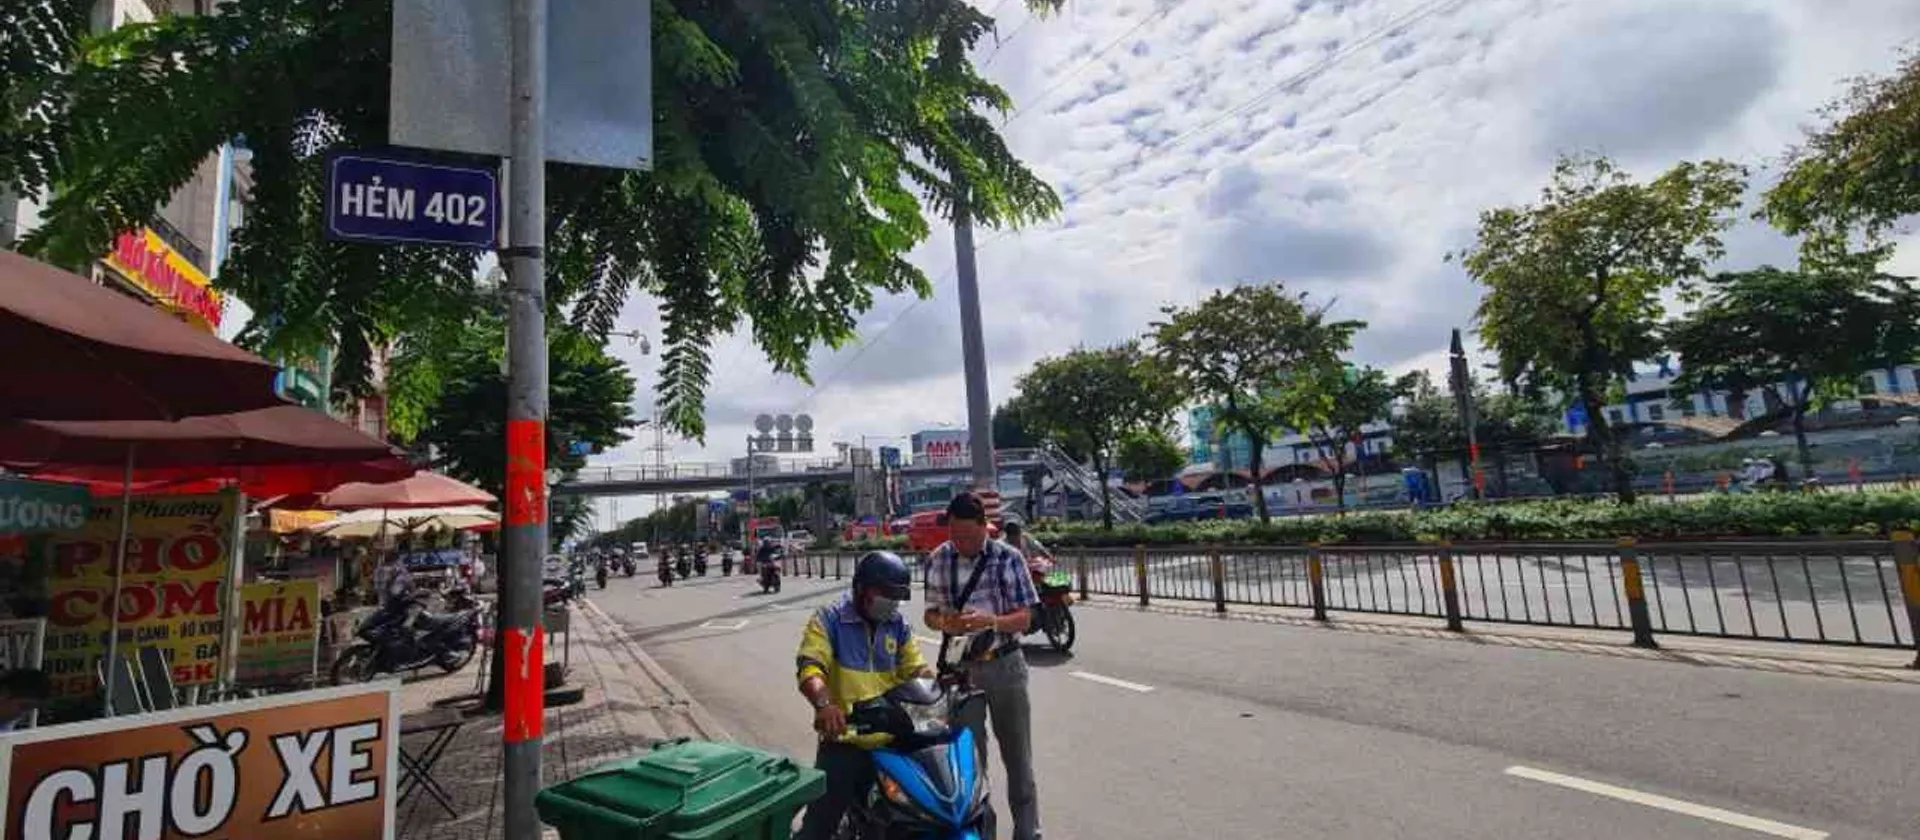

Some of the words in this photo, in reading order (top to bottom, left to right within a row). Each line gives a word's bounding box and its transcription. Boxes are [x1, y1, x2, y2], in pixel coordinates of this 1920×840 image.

[341, 176, 415, 221] HẺM
[424, 191, 486, 227] 402
[49, 580, 220, 627] CƠM
[244, 587, 312, 634] MÍA
[24, 724, 248, 840] CHỜ
[265, 720, 381, 820] XE
